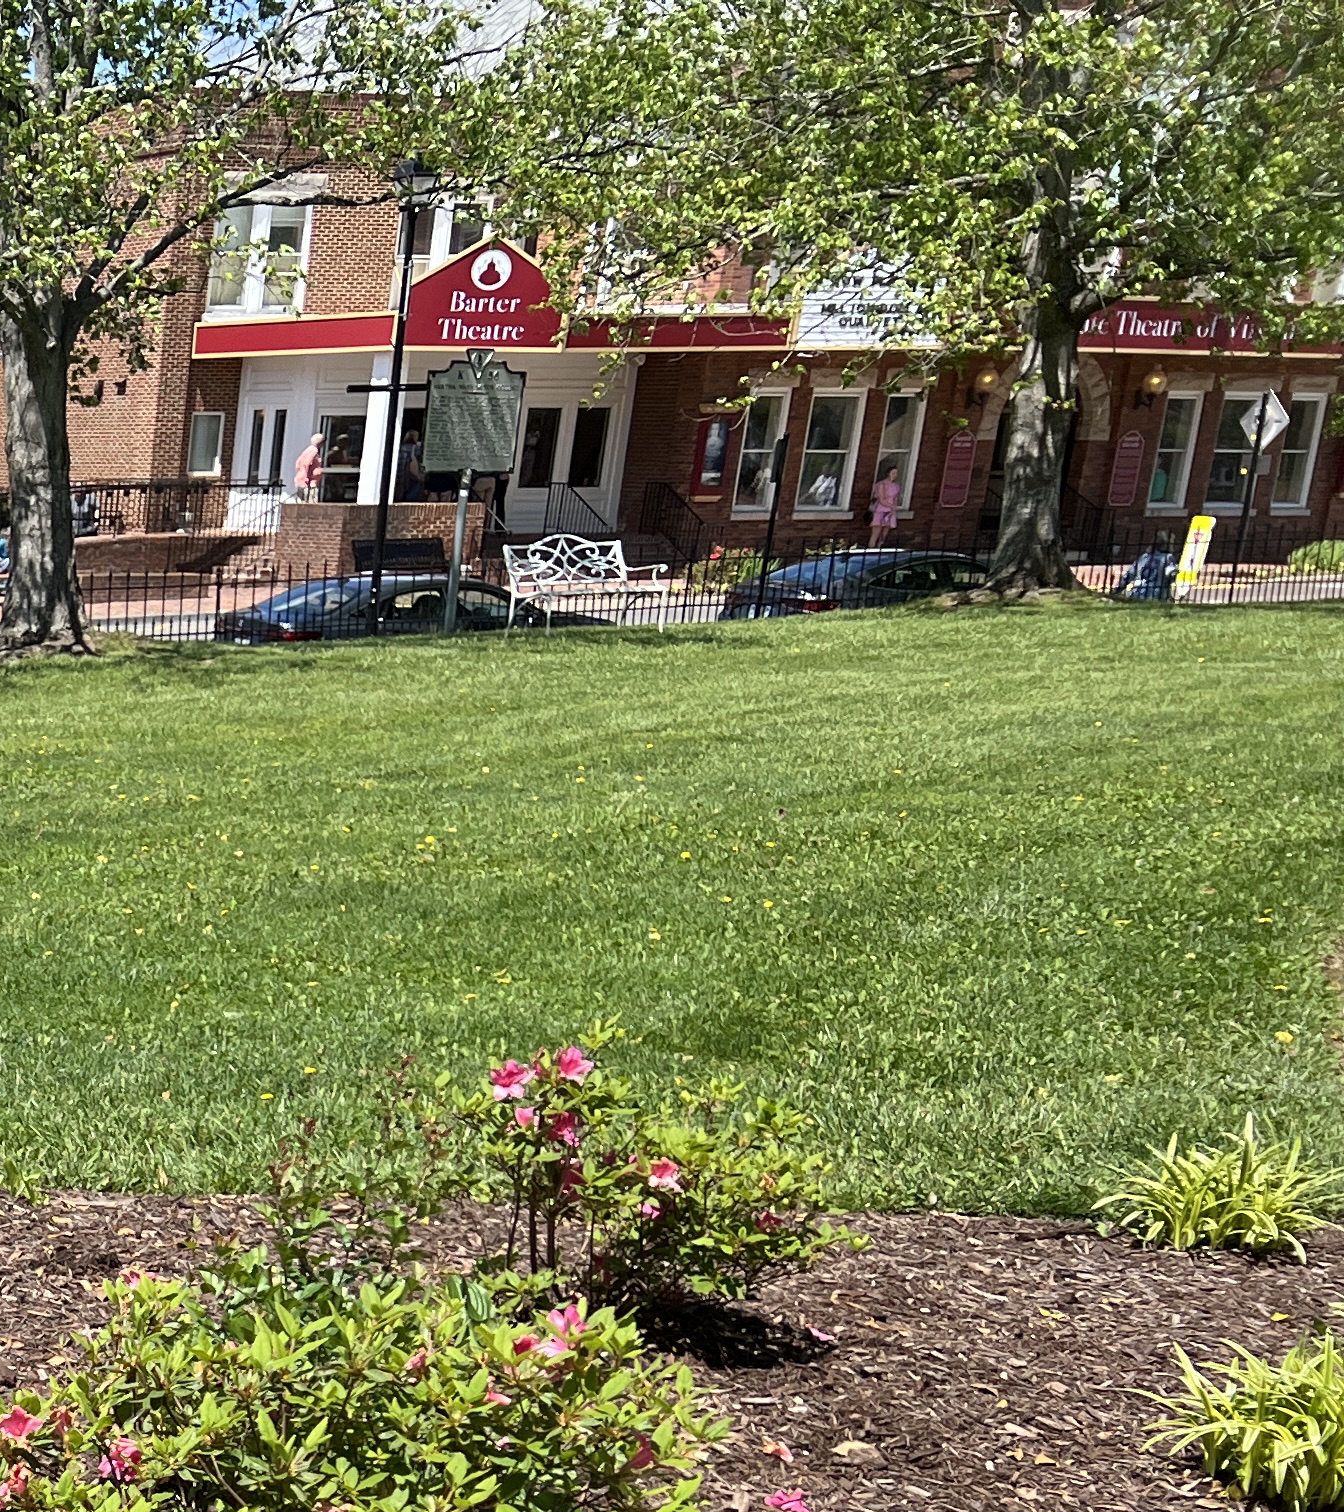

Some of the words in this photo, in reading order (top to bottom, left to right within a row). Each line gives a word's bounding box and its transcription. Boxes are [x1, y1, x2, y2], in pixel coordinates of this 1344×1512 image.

[450, 290, 521, 313] Barter
[438, 317, 525, 341] Theatre
[1116, 310, 1192, 337] Theatr
